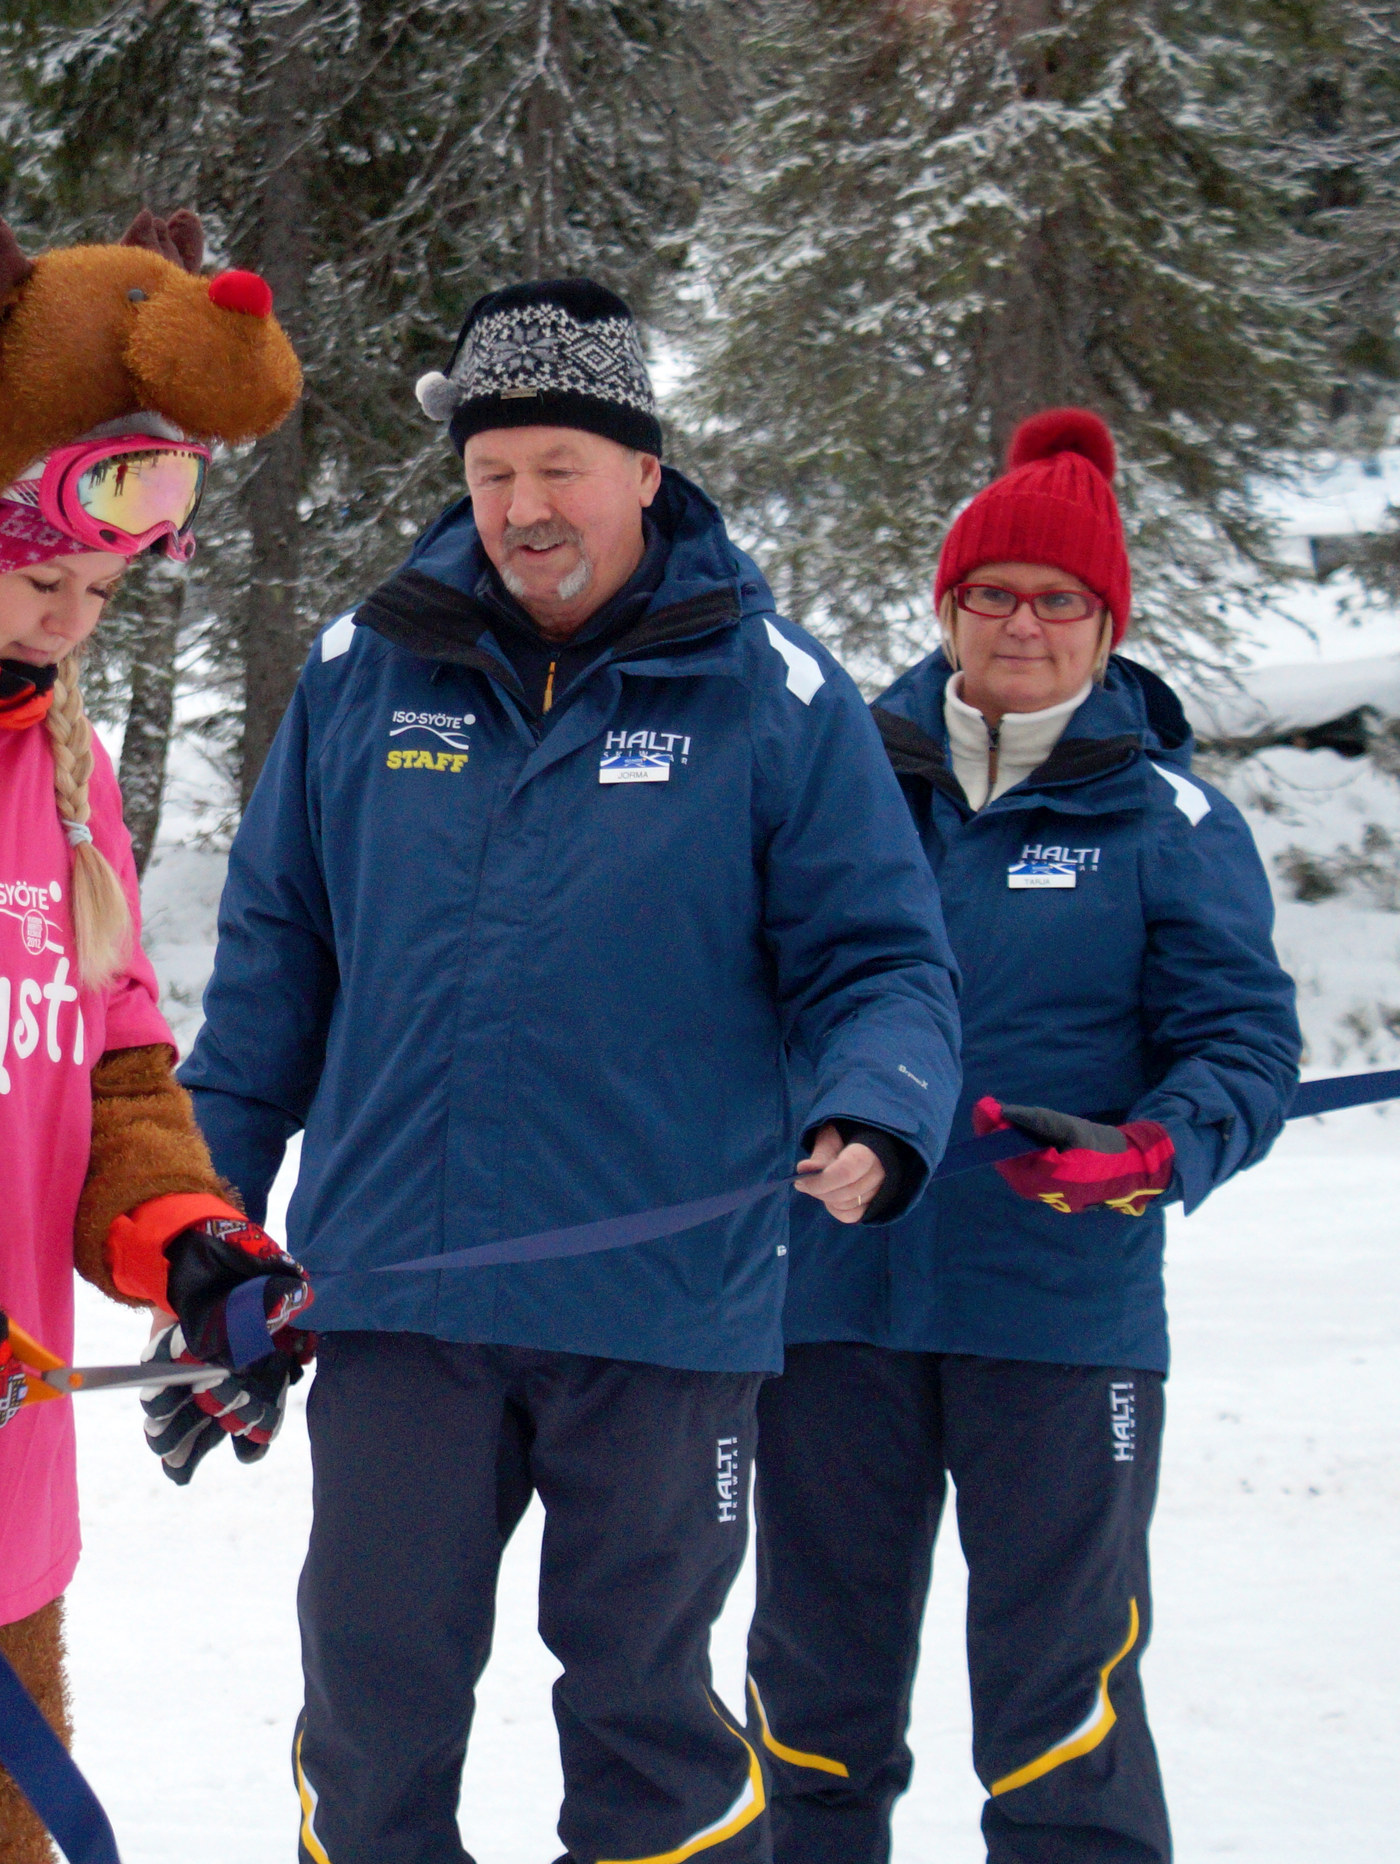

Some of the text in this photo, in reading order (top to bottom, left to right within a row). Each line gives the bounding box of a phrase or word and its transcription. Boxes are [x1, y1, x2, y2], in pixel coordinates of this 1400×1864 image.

[605, 731, 691, 755] HALTI
[386, 750, 469, 773] STAFF
[1021, 844, 1100, 863] HALTI
[1110, 1382, 1130, 1461] HALTI
[717, 1437, 732, 1523] HALTI
